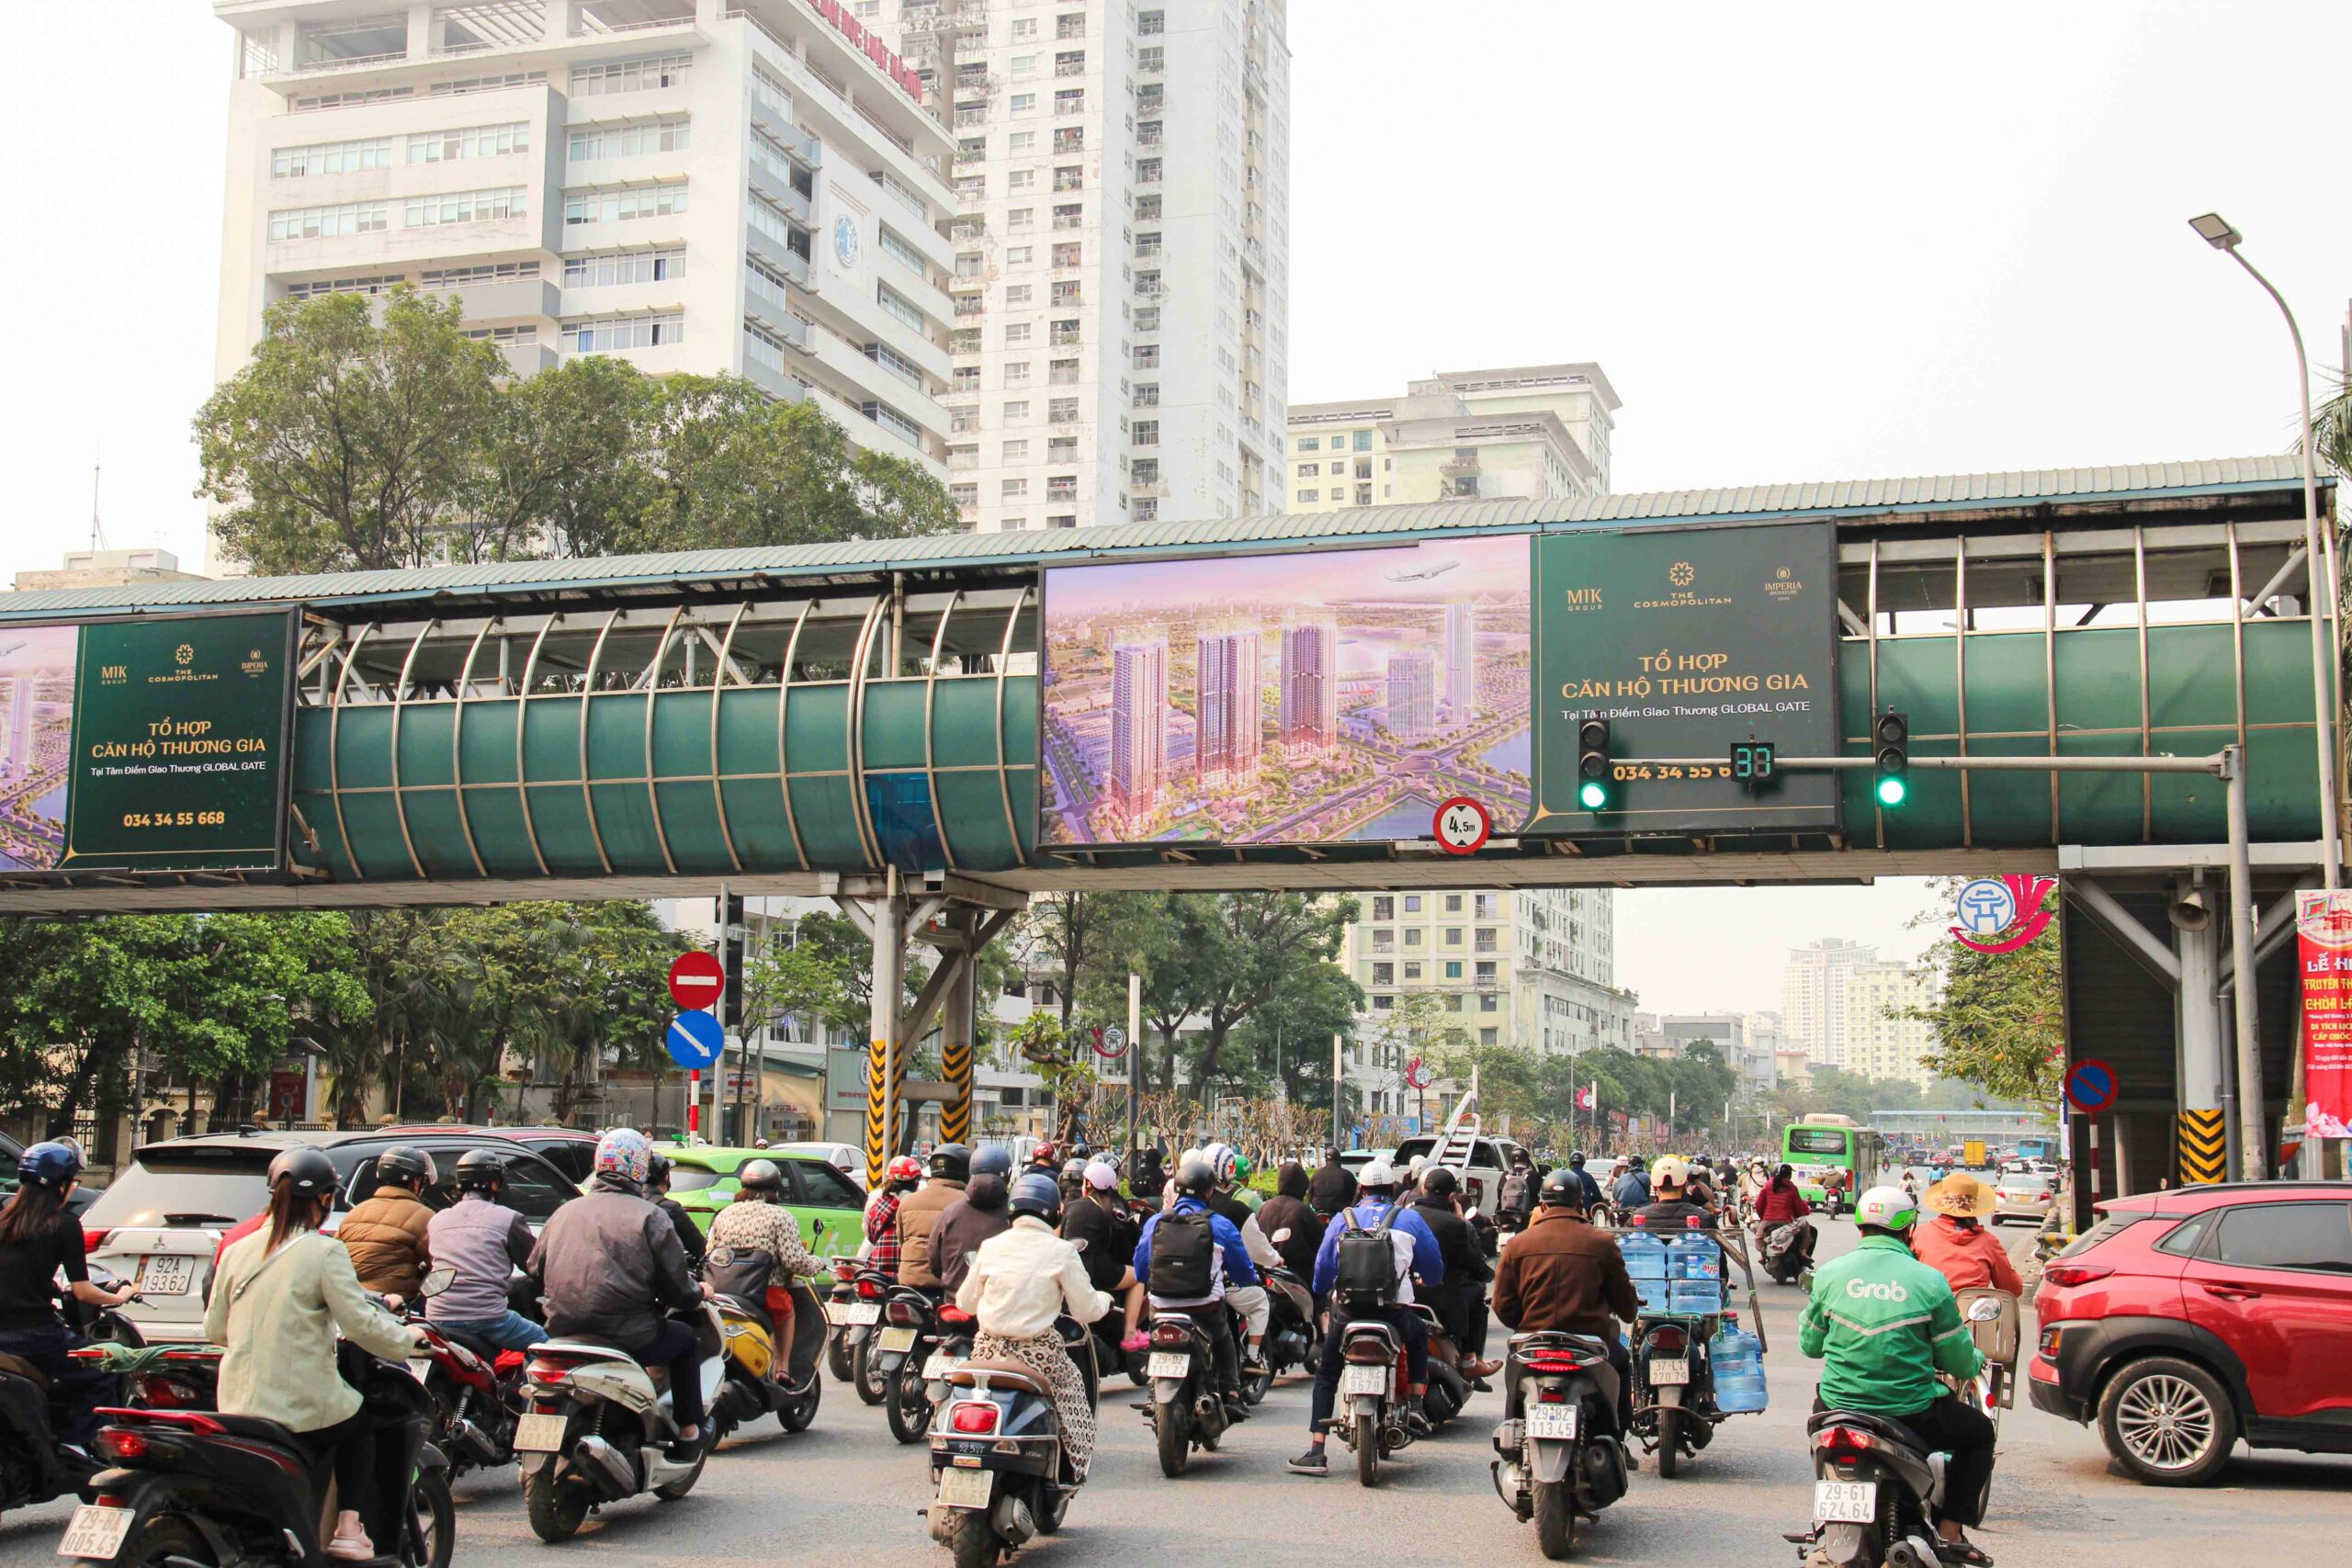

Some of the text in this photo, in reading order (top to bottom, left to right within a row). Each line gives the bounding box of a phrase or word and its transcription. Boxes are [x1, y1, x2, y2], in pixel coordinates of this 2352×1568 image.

[1765, 581, 1803, 592] IMPERIA
[1566, 588, 1603, 604] MIK
[1634, 597, 1733, 609] COSMOPOLITAN
[1670, 592, 1695, 600] THE
[1638, 649, 1728, 672] TỔ HỢP
[102, 666, 128, 679] MIK
[148, 674, 219, 683] COSMOPOLITAN
[1561, 673, 1809, 699] CĂN HỘ THƯƠNG GIA
[1561, 710, 1579, 721] Tại
[1610, 706, 1640, 718] Điểm
[1643, 706, 1670, 716] Giao
[1672, 705, 1718, 717] Thương
[1721, 703, 1773, 715] GLOBAL
[1775, 701, 1810, 713] GATE
[149, 716, 211, 737] TỔ HỢP
[92, 738, 266, 758] CĂN HỘ THƯƠNG GIA
[106, 767, 124, 776] Tâm
[148, 764, 167, 774] Giao
[168, 764, 201, 774] Thương
[203, 762, 239, 773] GLOBAL
[241, 761, 266, 771] GATE
[1736, 747, 1770, 778] 37
[123, 810, 225, 828] 034 34 55 668
[156, 1258, 181, 1273] 92A
[1846, 1278, 1907, 1303] Grab
[1824, 1483, 1867, 1501] 29-G1
[1818, 1502, 1871, 1519] 624.64
